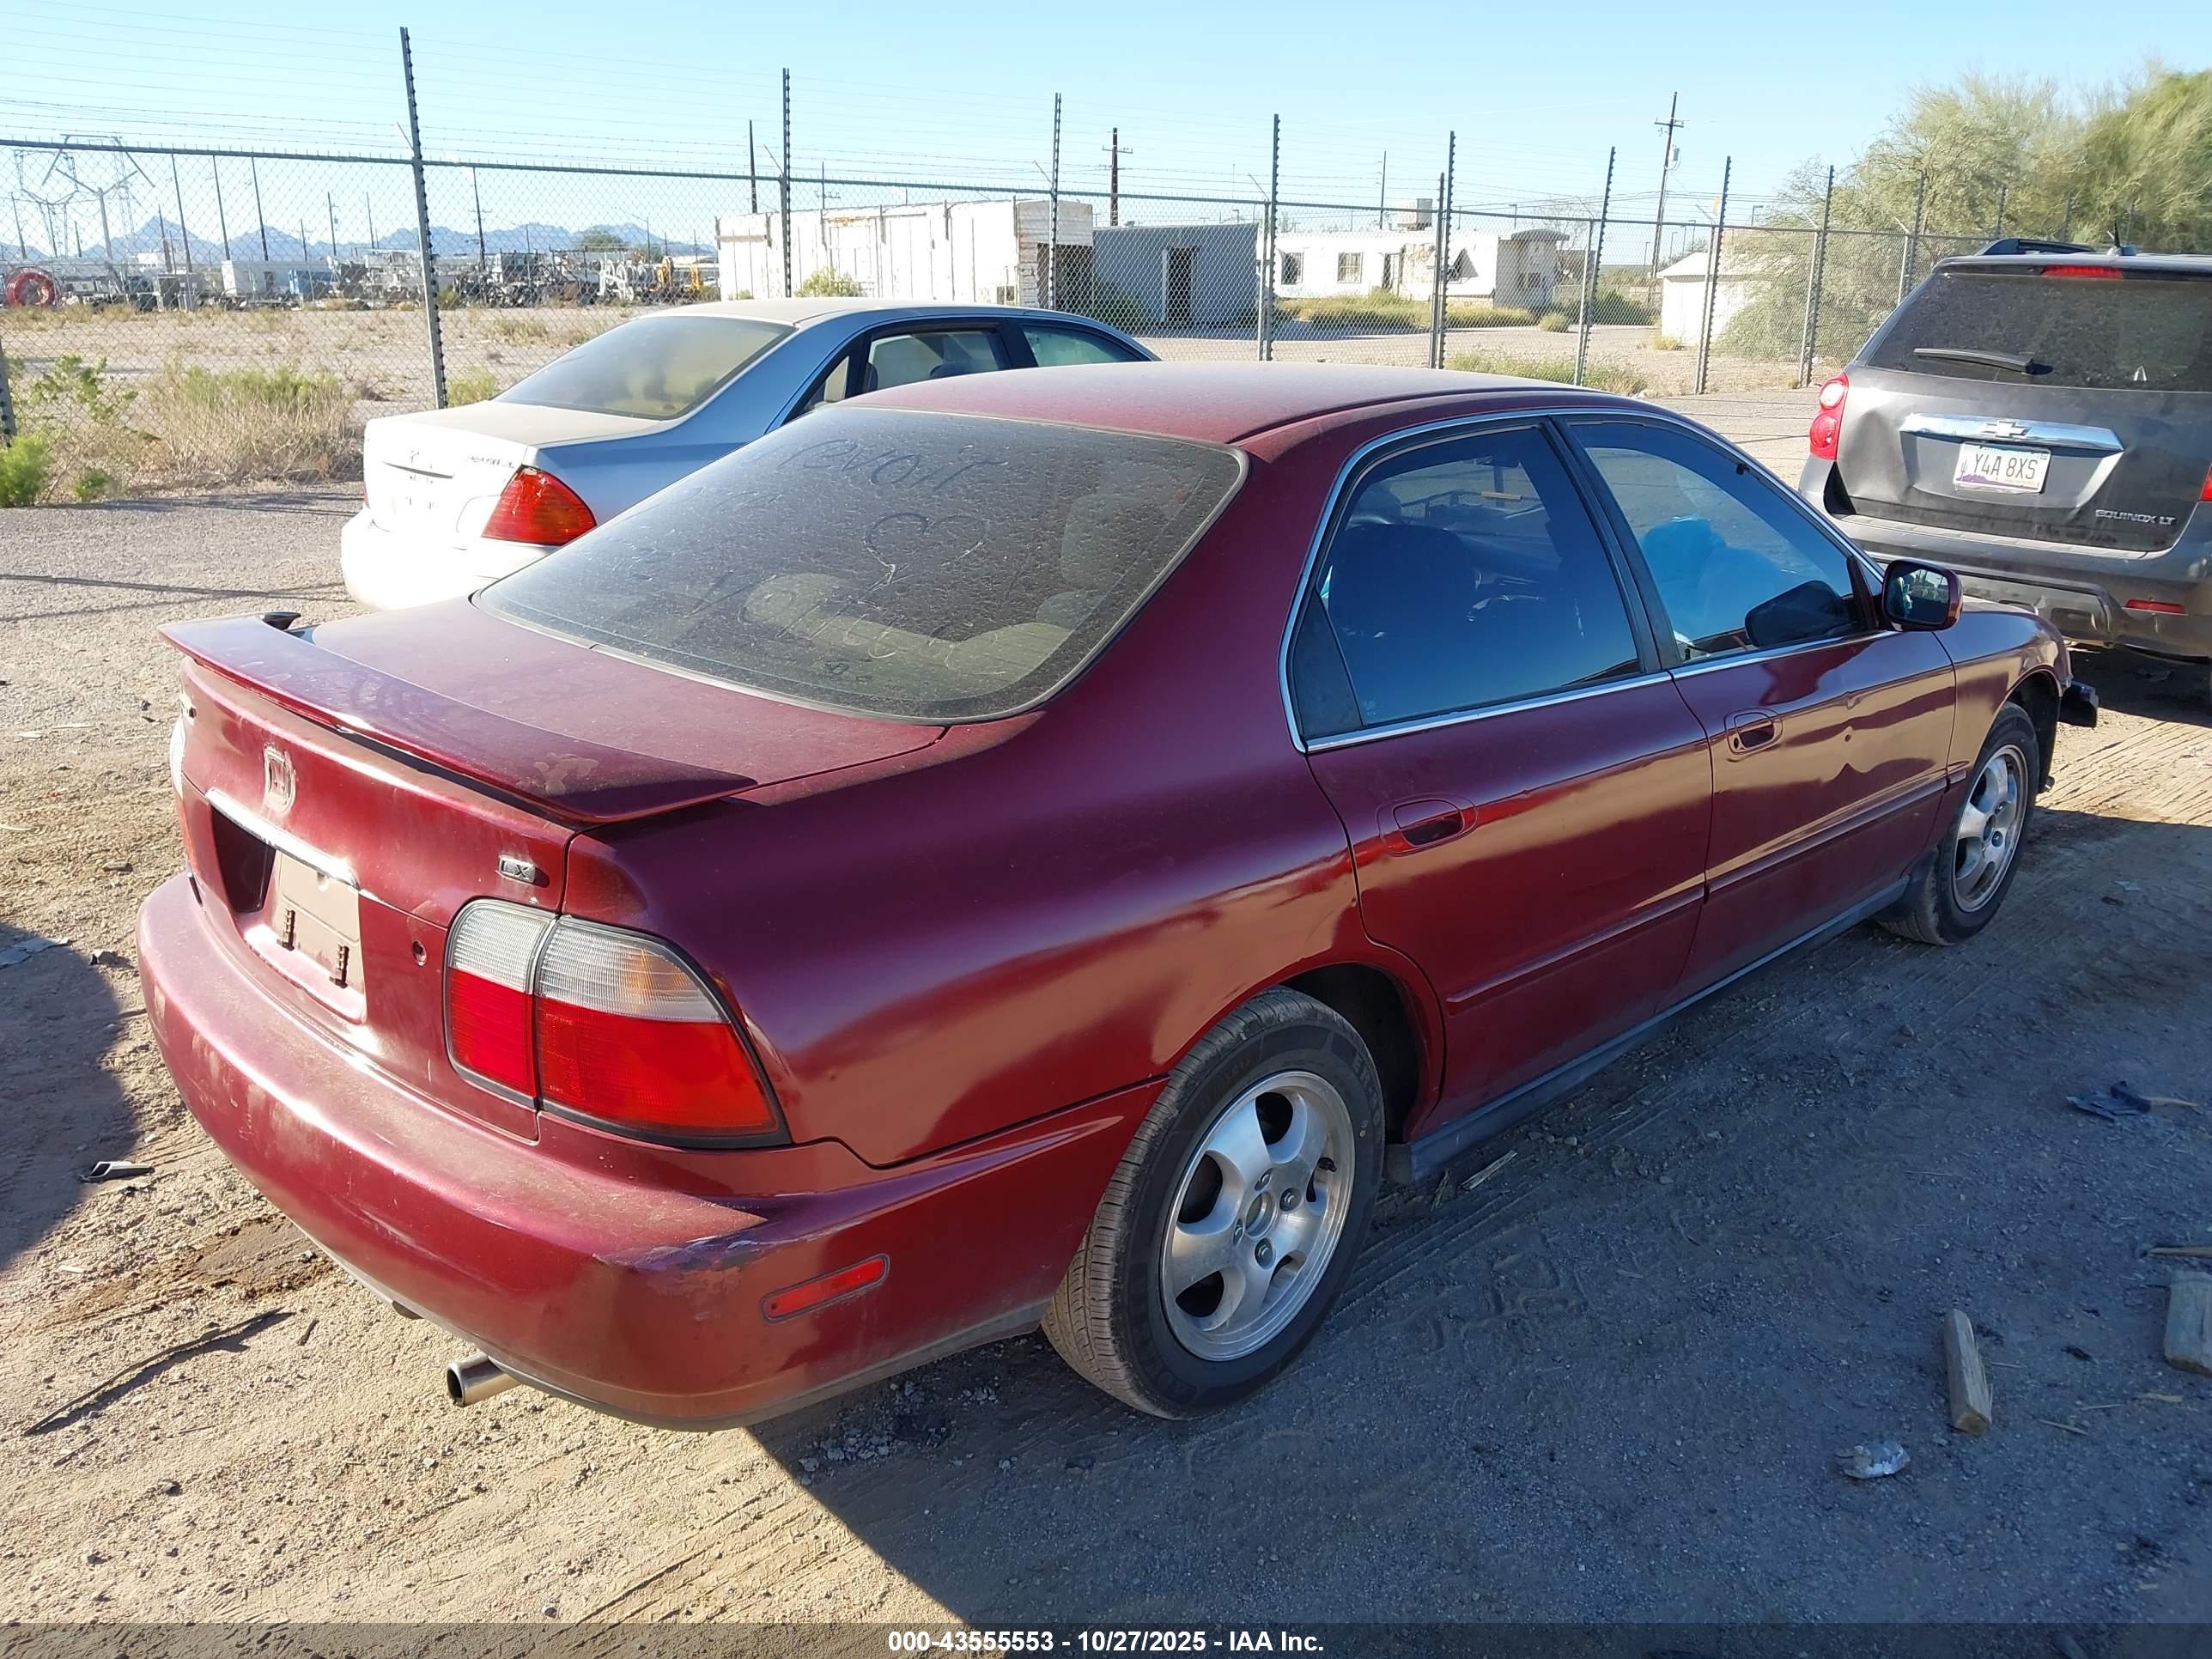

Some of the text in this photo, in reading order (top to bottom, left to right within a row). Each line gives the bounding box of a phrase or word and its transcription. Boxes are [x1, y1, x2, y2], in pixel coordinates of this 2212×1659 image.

[1974, 453, 2039, 480] Y4A 8XS
[2095, 509, 2176, 525] EQUINOX LT
